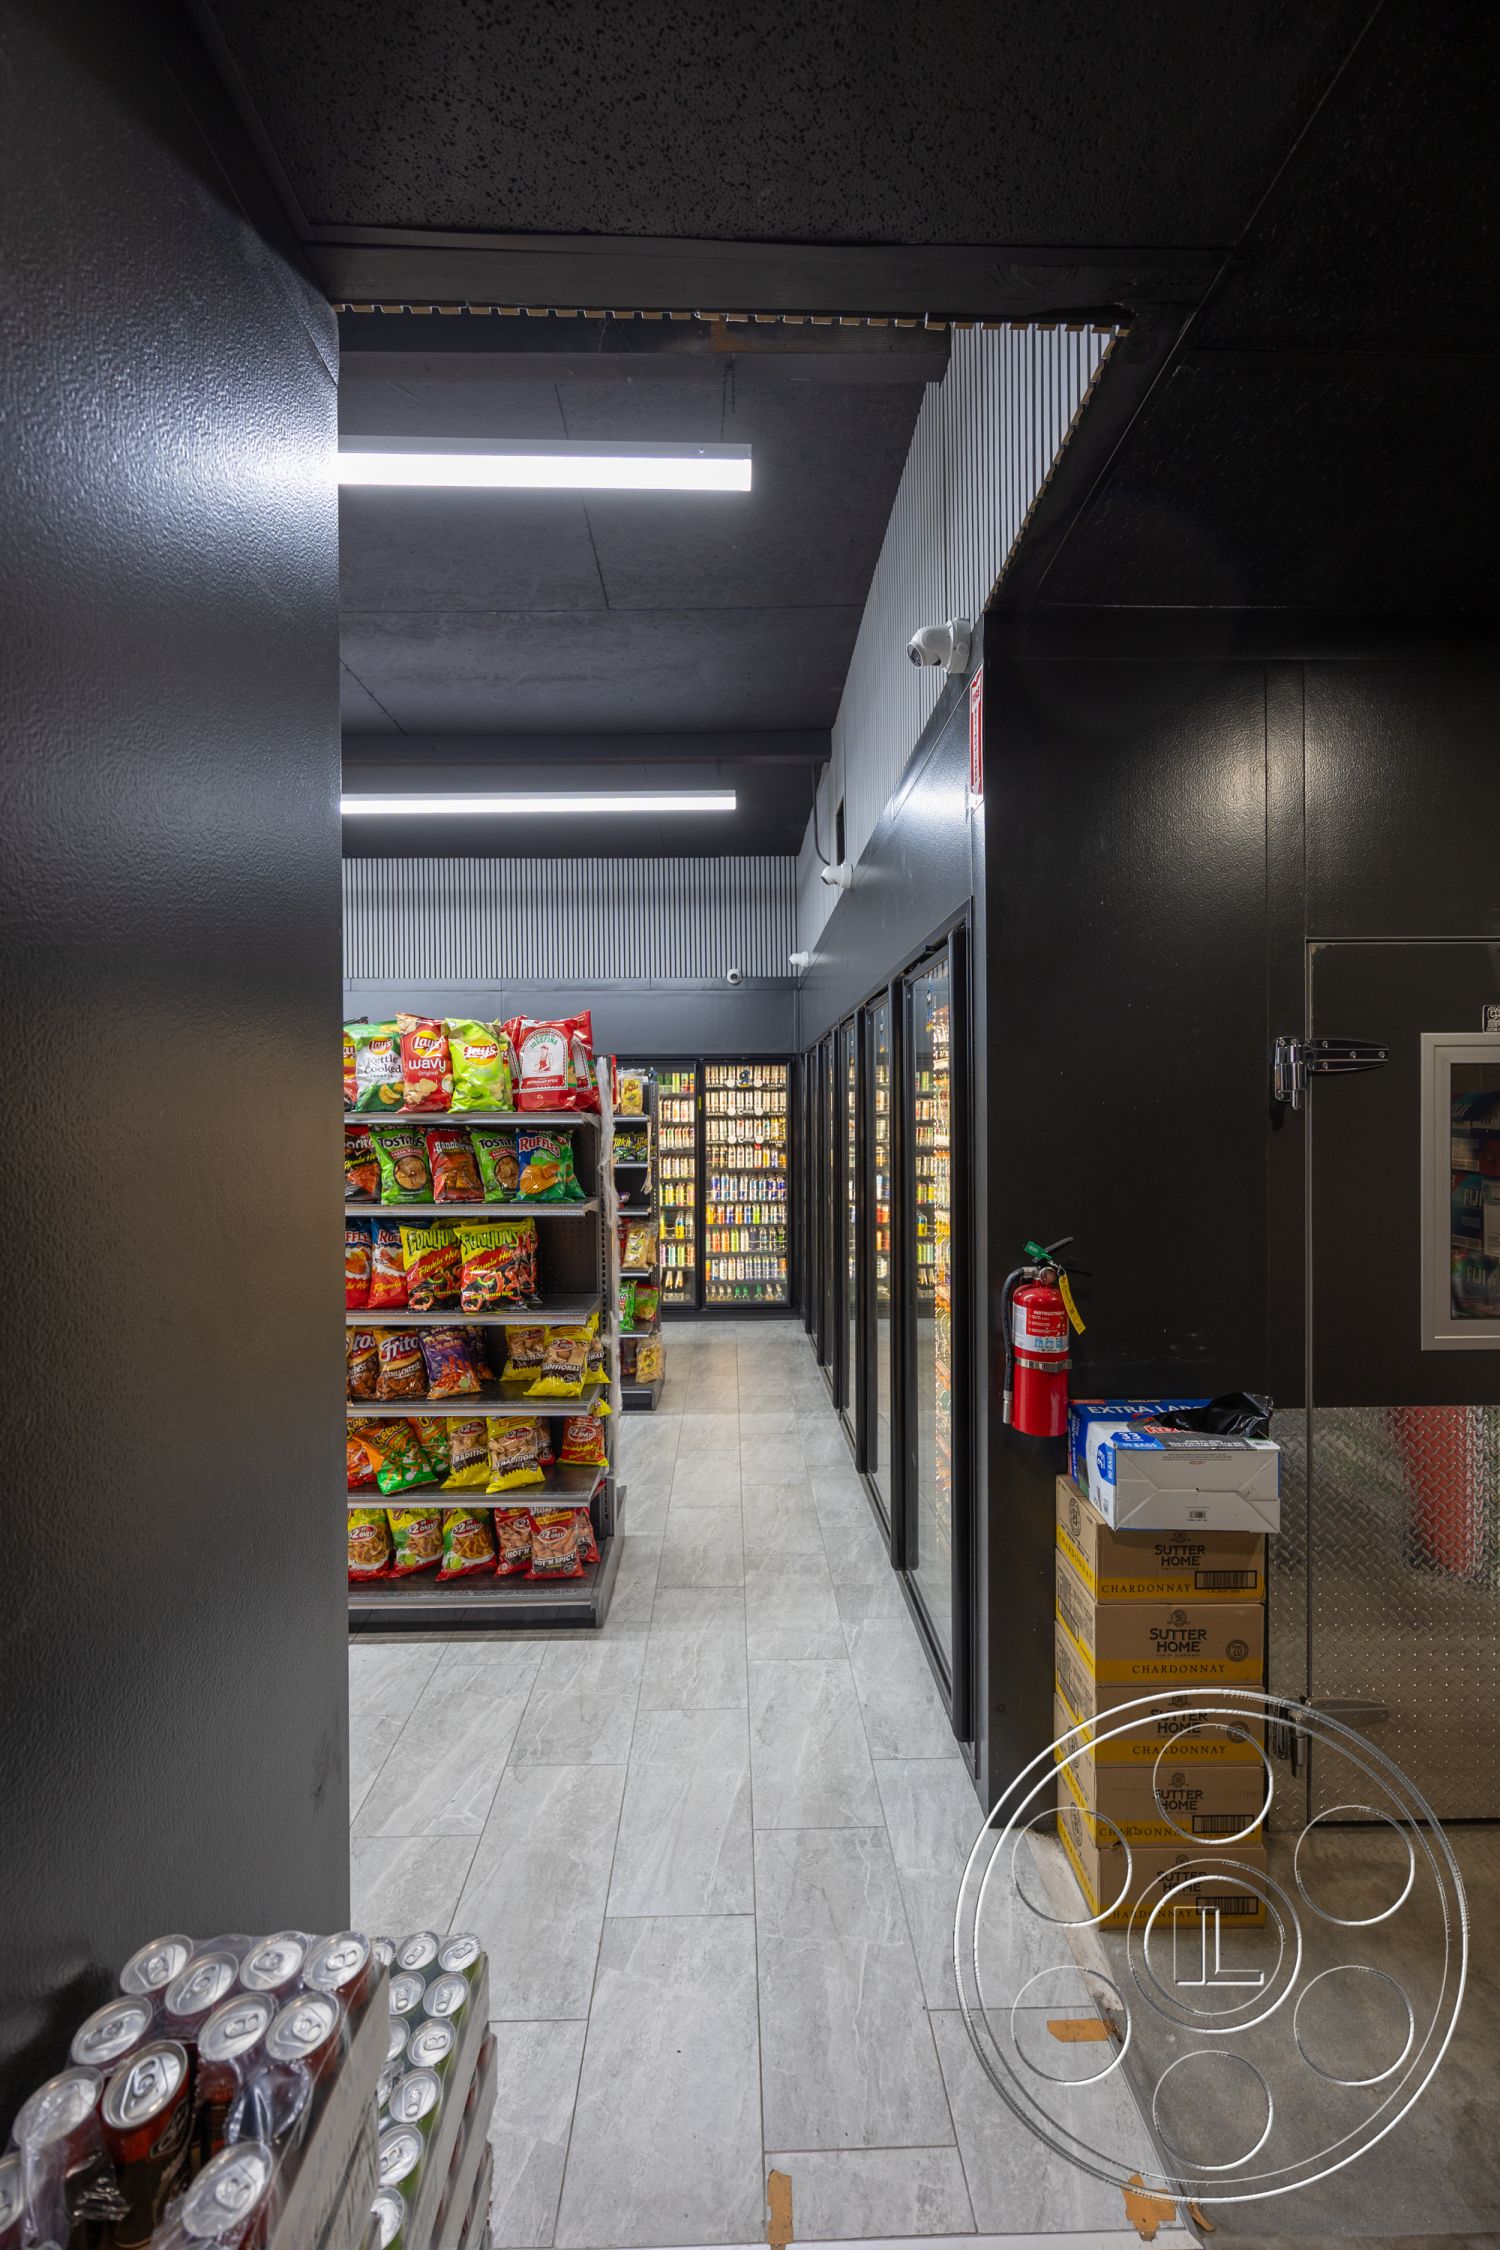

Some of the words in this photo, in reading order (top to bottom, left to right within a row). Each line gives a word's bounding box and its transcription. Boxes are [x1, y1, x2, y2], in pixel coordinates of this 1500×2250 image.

[409, 1058, 446, 1072] wavy
[518, 1136, 561, 1157] RUFFLES
[1088, 1406, 1150, 1414] EXTRA
[1120, 1432, 1141, 1441] 33
[452, 1448, 487, 1464] TRADITIO
[1155, 1544, 1206, 1555] SUTTER
[1161, 1556, 1200, 1566] HOME
[1101, 1584, 1191, 1593] CHARDONNAY
[1149, 1628, 1207, 1640] SUTTER
[1157, 1641, 1200, 1652] HOME
[1132, 1664, 1226, 1674] CHARDONNAY
[1157, 1722, 1201, 1733] HOME
[1132, 1745, 1226, 1754] CHARDONNAY
